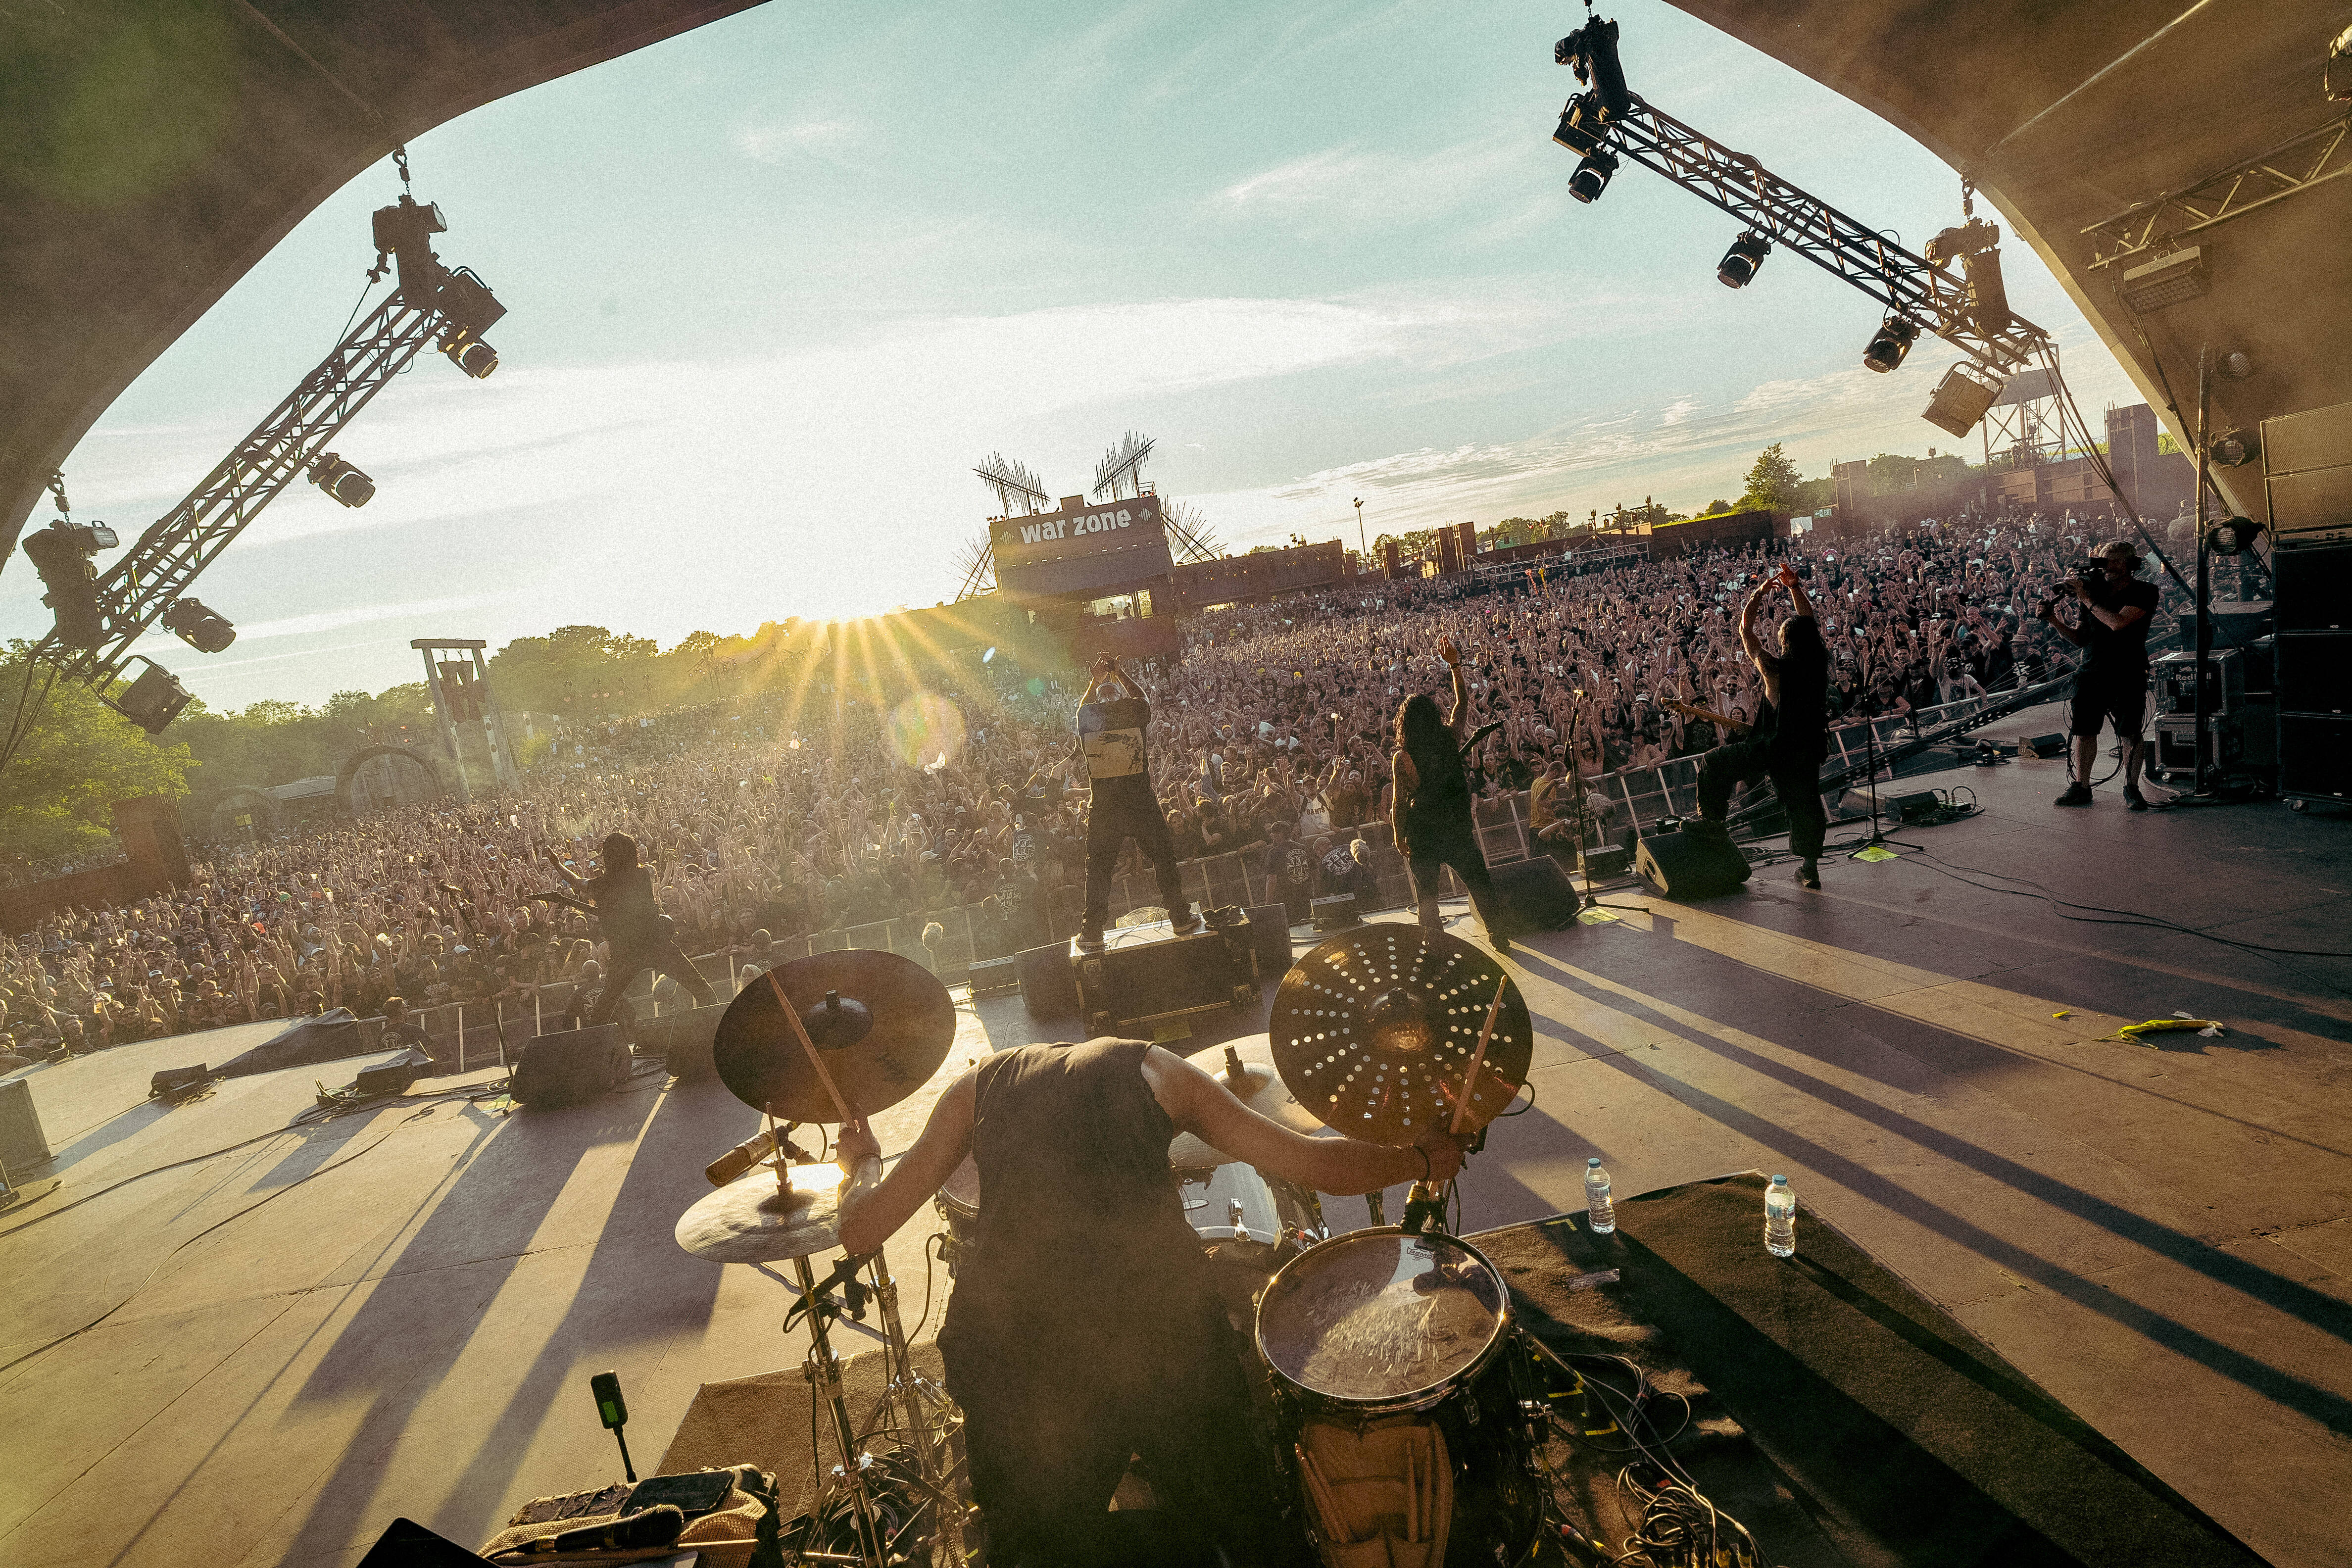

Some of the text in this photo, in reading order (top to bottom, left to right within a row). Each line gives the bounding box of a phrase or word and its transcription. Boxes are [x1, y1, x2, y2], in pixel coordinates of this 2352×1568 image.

[1020, 508, 1132, 544] war zone
[1409, 1250, 1432, 1258] REMO
